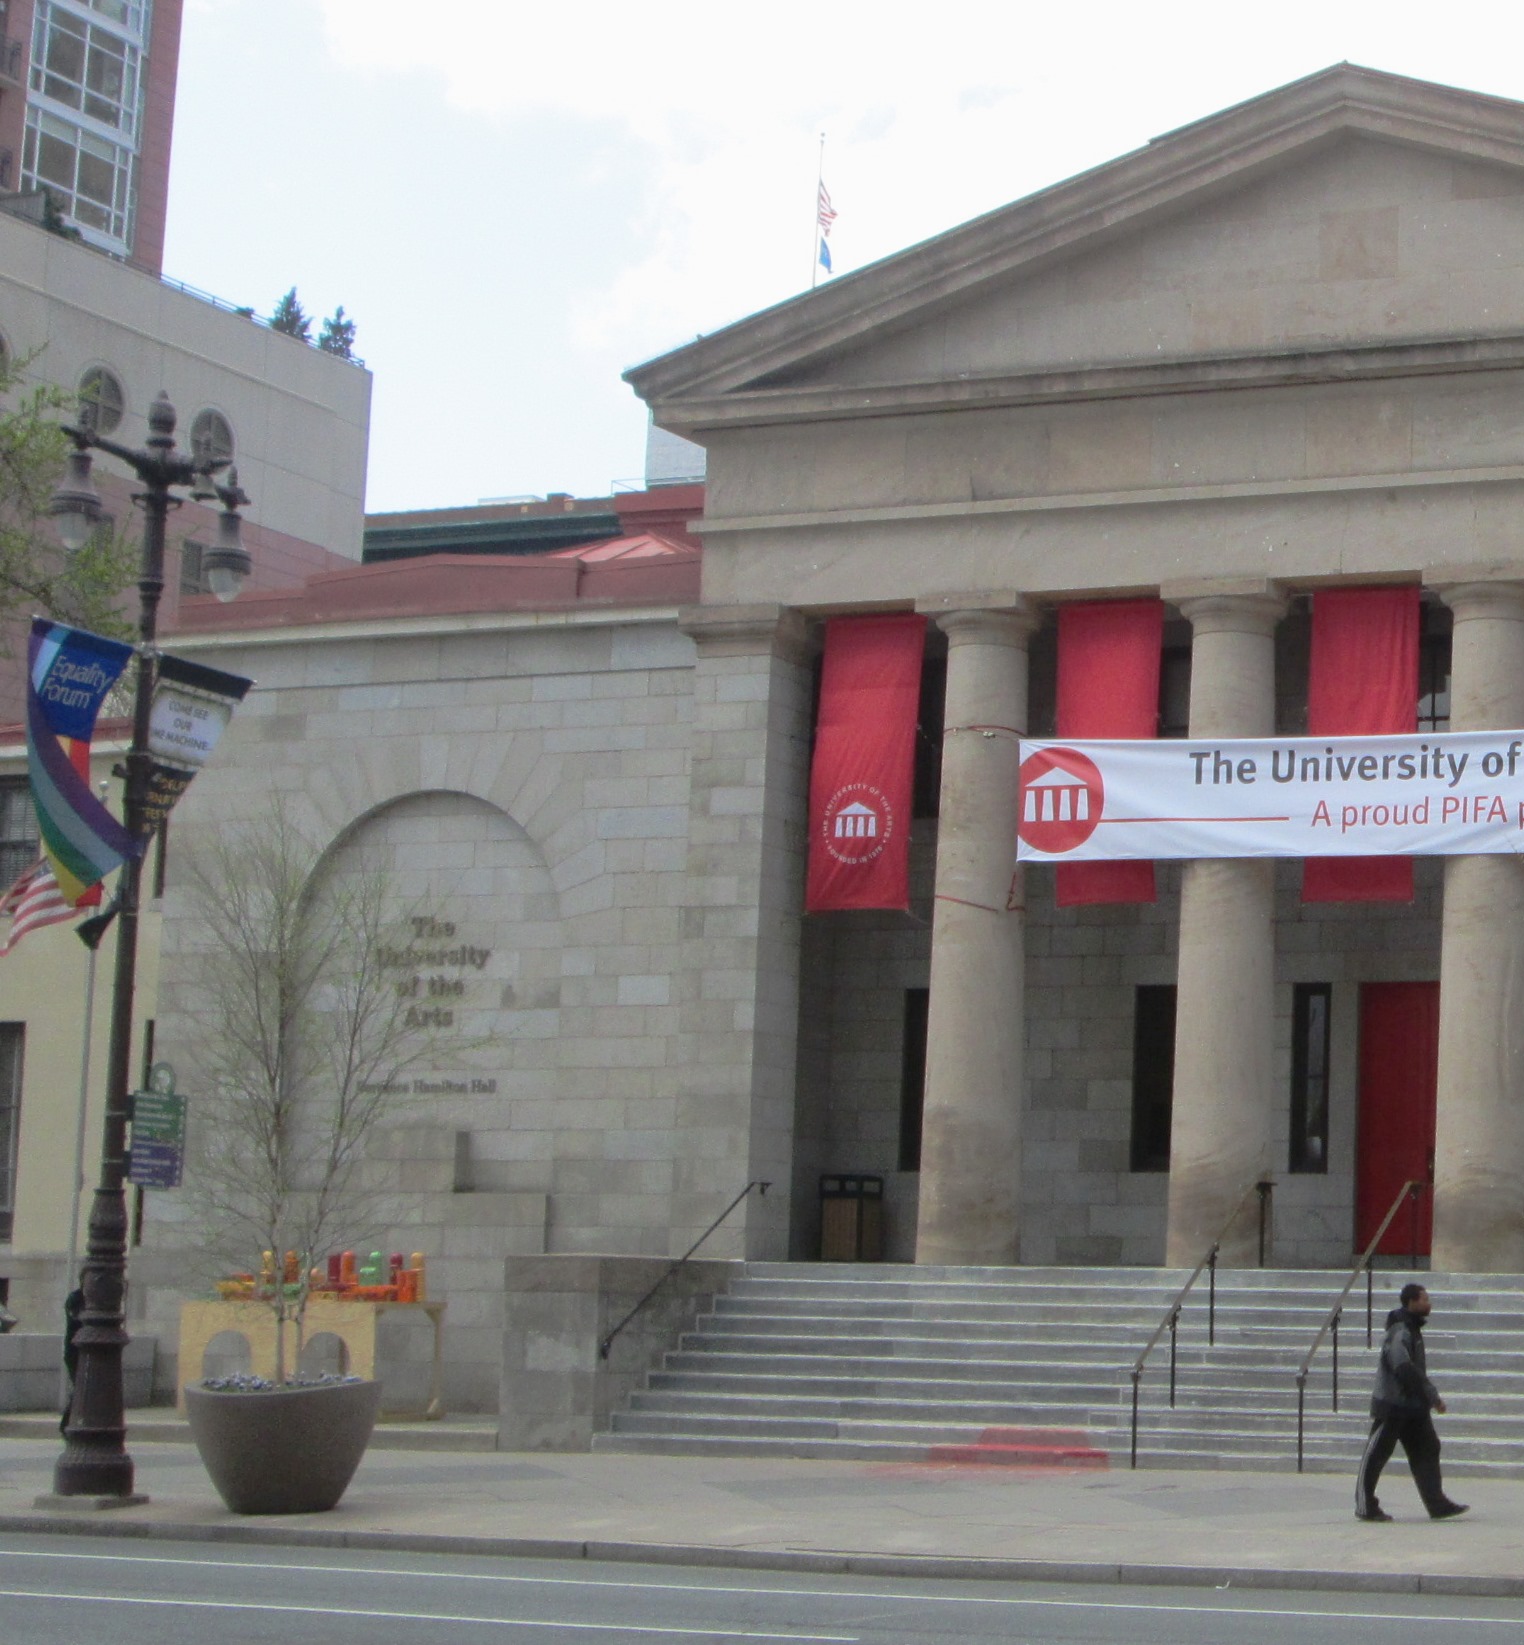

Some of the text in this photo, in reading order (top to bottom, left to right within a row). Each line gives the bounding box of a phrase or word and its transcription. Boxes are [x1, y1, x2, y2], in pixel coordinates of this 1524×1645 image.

[52, 655, 114, 694] Equality
[41, 677, 94, 709] Forum
[1188, 750, 1257, 785] The
[1271, 743, 1469, 788] University
[1481, 741, 1522, 777] of
[825, 784, 867, 816] UNIVERSITY
[869, 786, 880, 796] OF
[884, 816, 893, 837] ARTS
[1311, 799, 1332, 827] A
[1341, 795, 1430, 834] proud
[1441, 795, 1508, 824] PIFA
[827, 844, 858, 865] FOUNDED
[411, 915, 456, 938] The
[374, 944, 492, 971] University
[396, 974, 464, 997] of the
[405, 1005, 454, 1027] Arts
[471, 1078, 497, 1094] Hall
